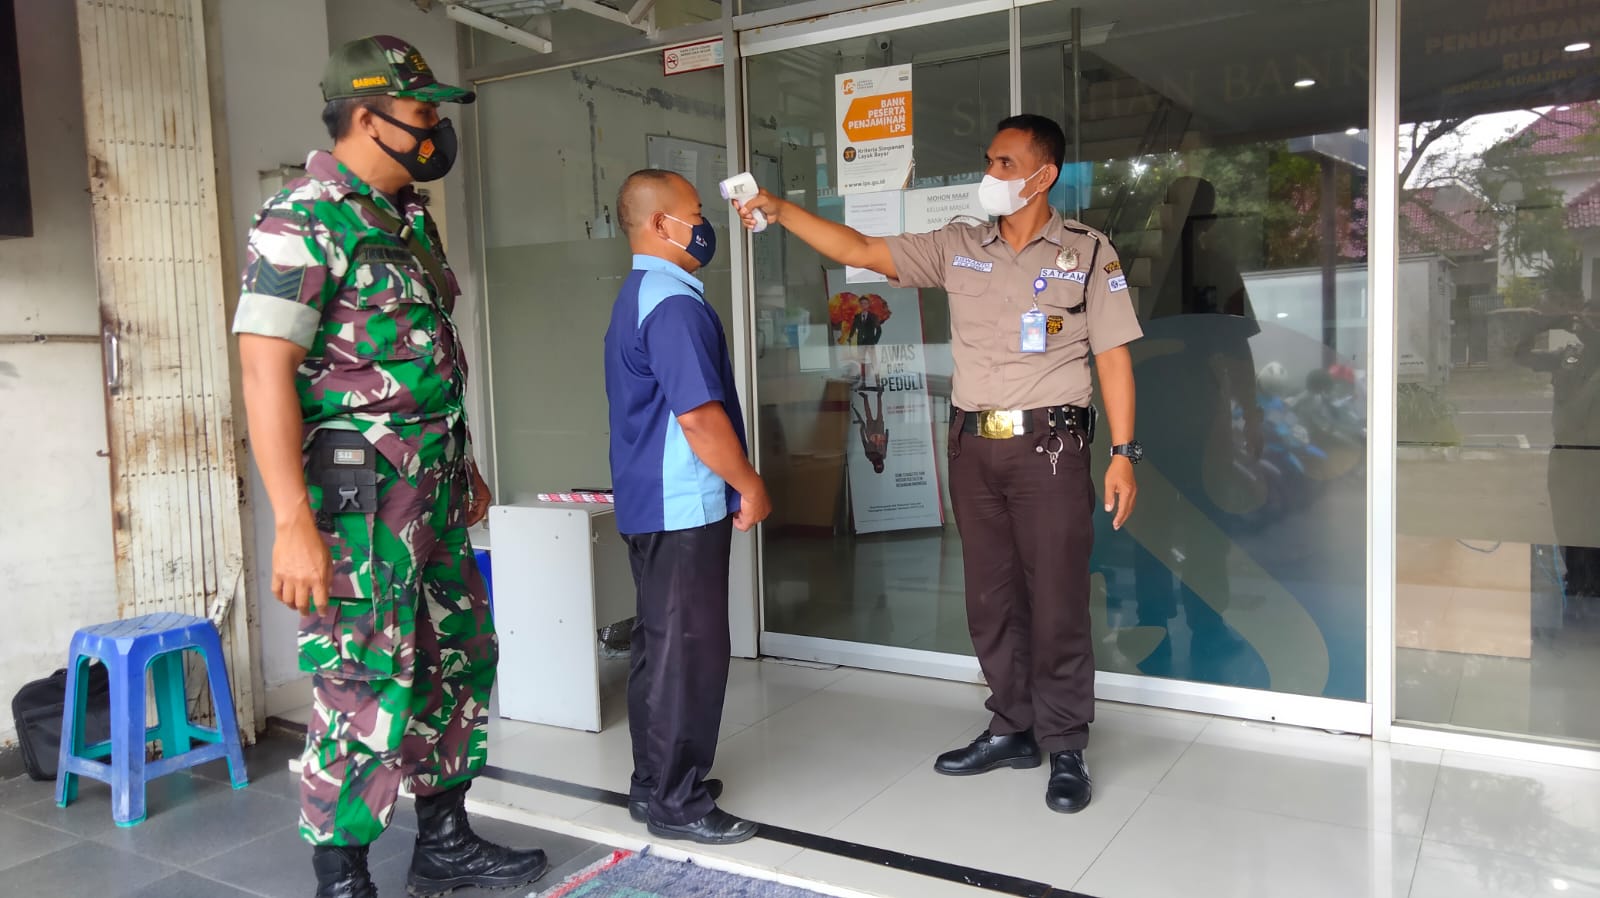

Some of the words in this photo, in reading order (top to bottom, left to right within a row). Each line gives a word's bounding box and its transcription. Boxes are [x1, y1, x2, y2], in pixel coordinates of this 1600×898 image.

[881, 97, 905, 108] BANK
[868, 106, 906, 118] PESERTA
[848, 115, 906, 130] PENJAMINAN
[890, 124, 906, 133] LPS
[858, 152, 873, 160] Layak
[874, 151, 889, 159] Bayar
[927, 192, 950, 202] MOHON
[1041, 269, 1085, 282] SATPAM
[881, 344, 915, 363] AWAS
[881, 372, 923, 392] PEDULI
